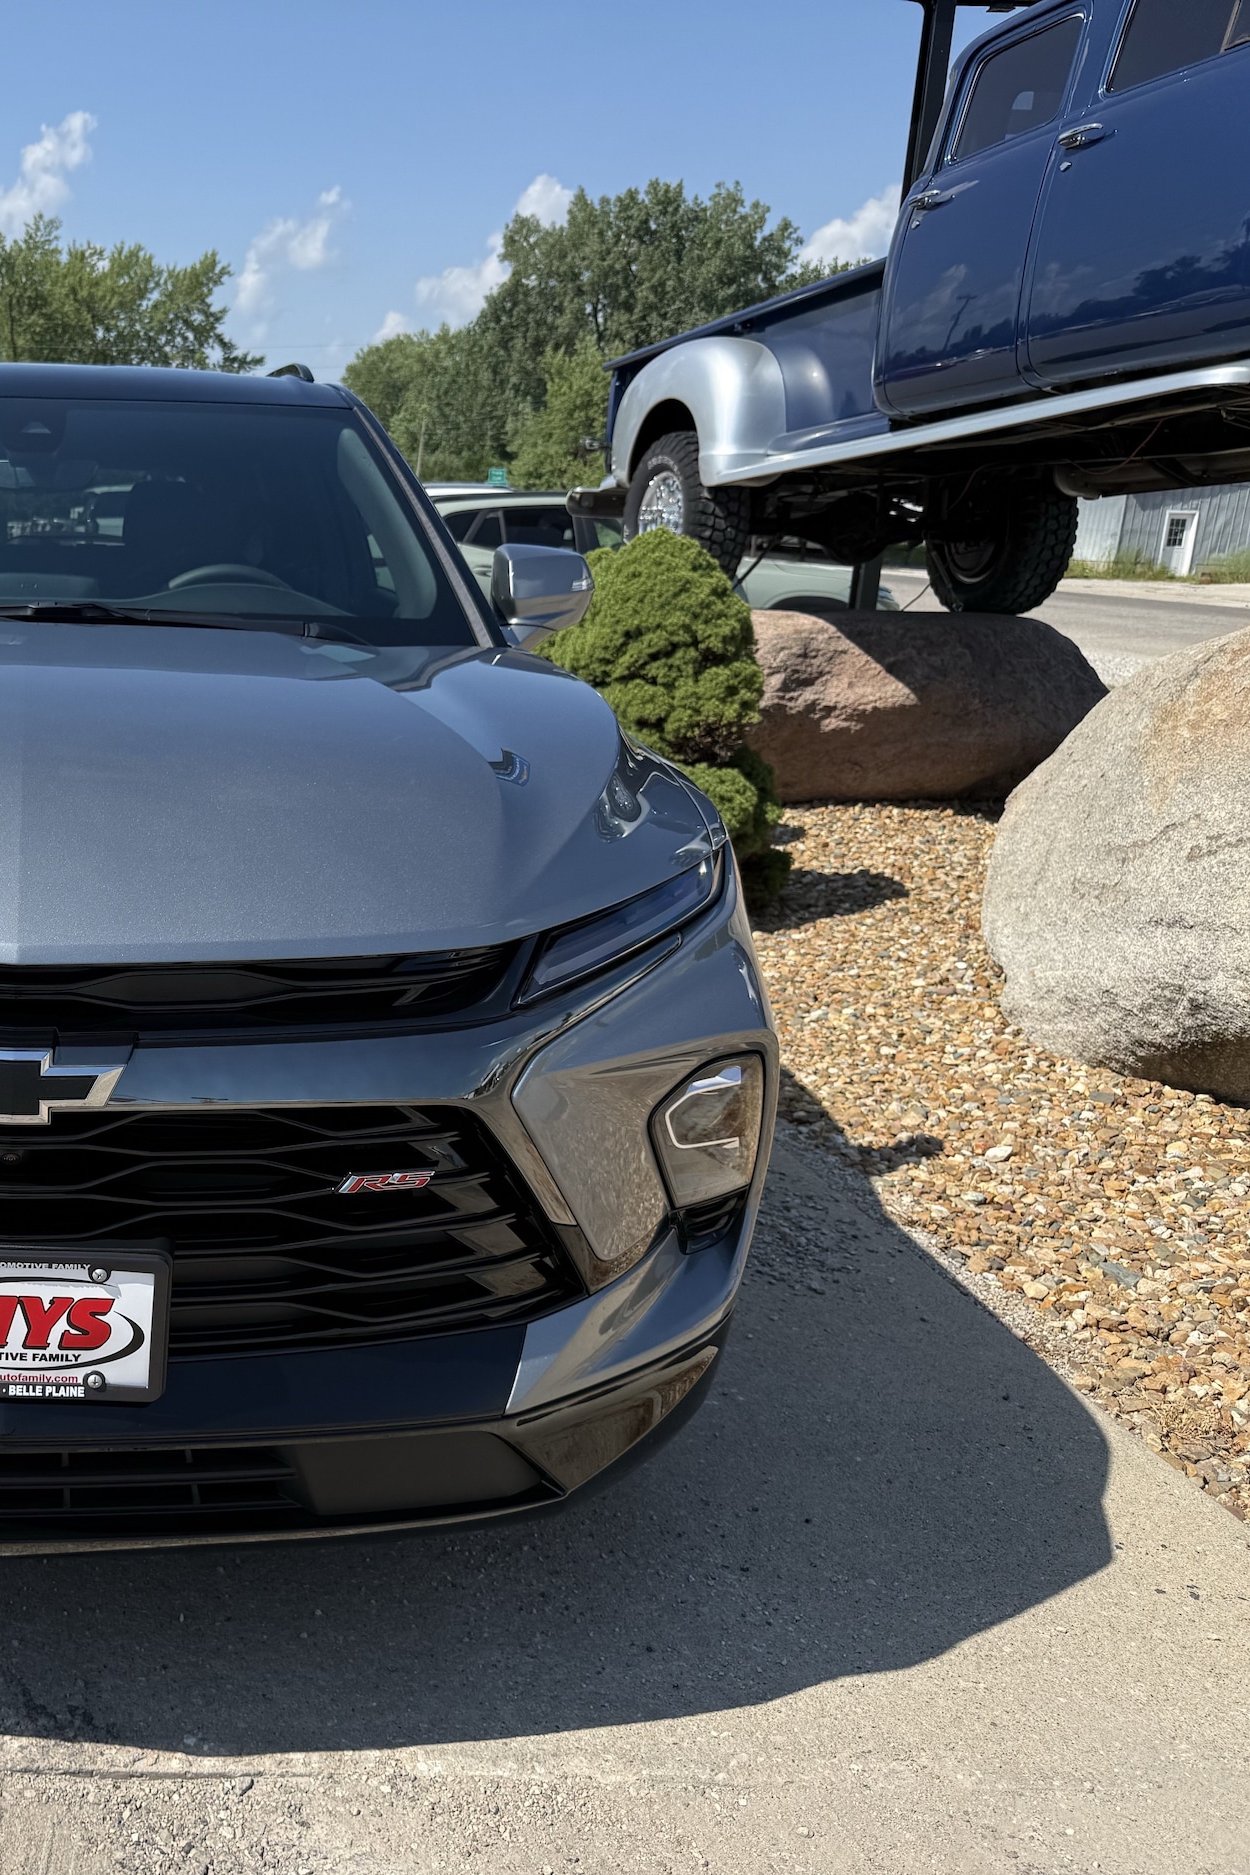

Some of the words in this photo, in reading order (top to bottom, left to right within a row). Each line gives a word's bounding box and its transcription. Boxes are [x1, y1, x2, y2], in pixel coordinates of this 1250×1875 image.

[338, 1172, 434, 1194] RS
[52, 1263, 92, 1271] FAMILY
[32, 1353, 82, 1363] FAMILY
[8, 1385, 43, 1397] BELLE
[45, 1387, 86, 1398] PLAINE
